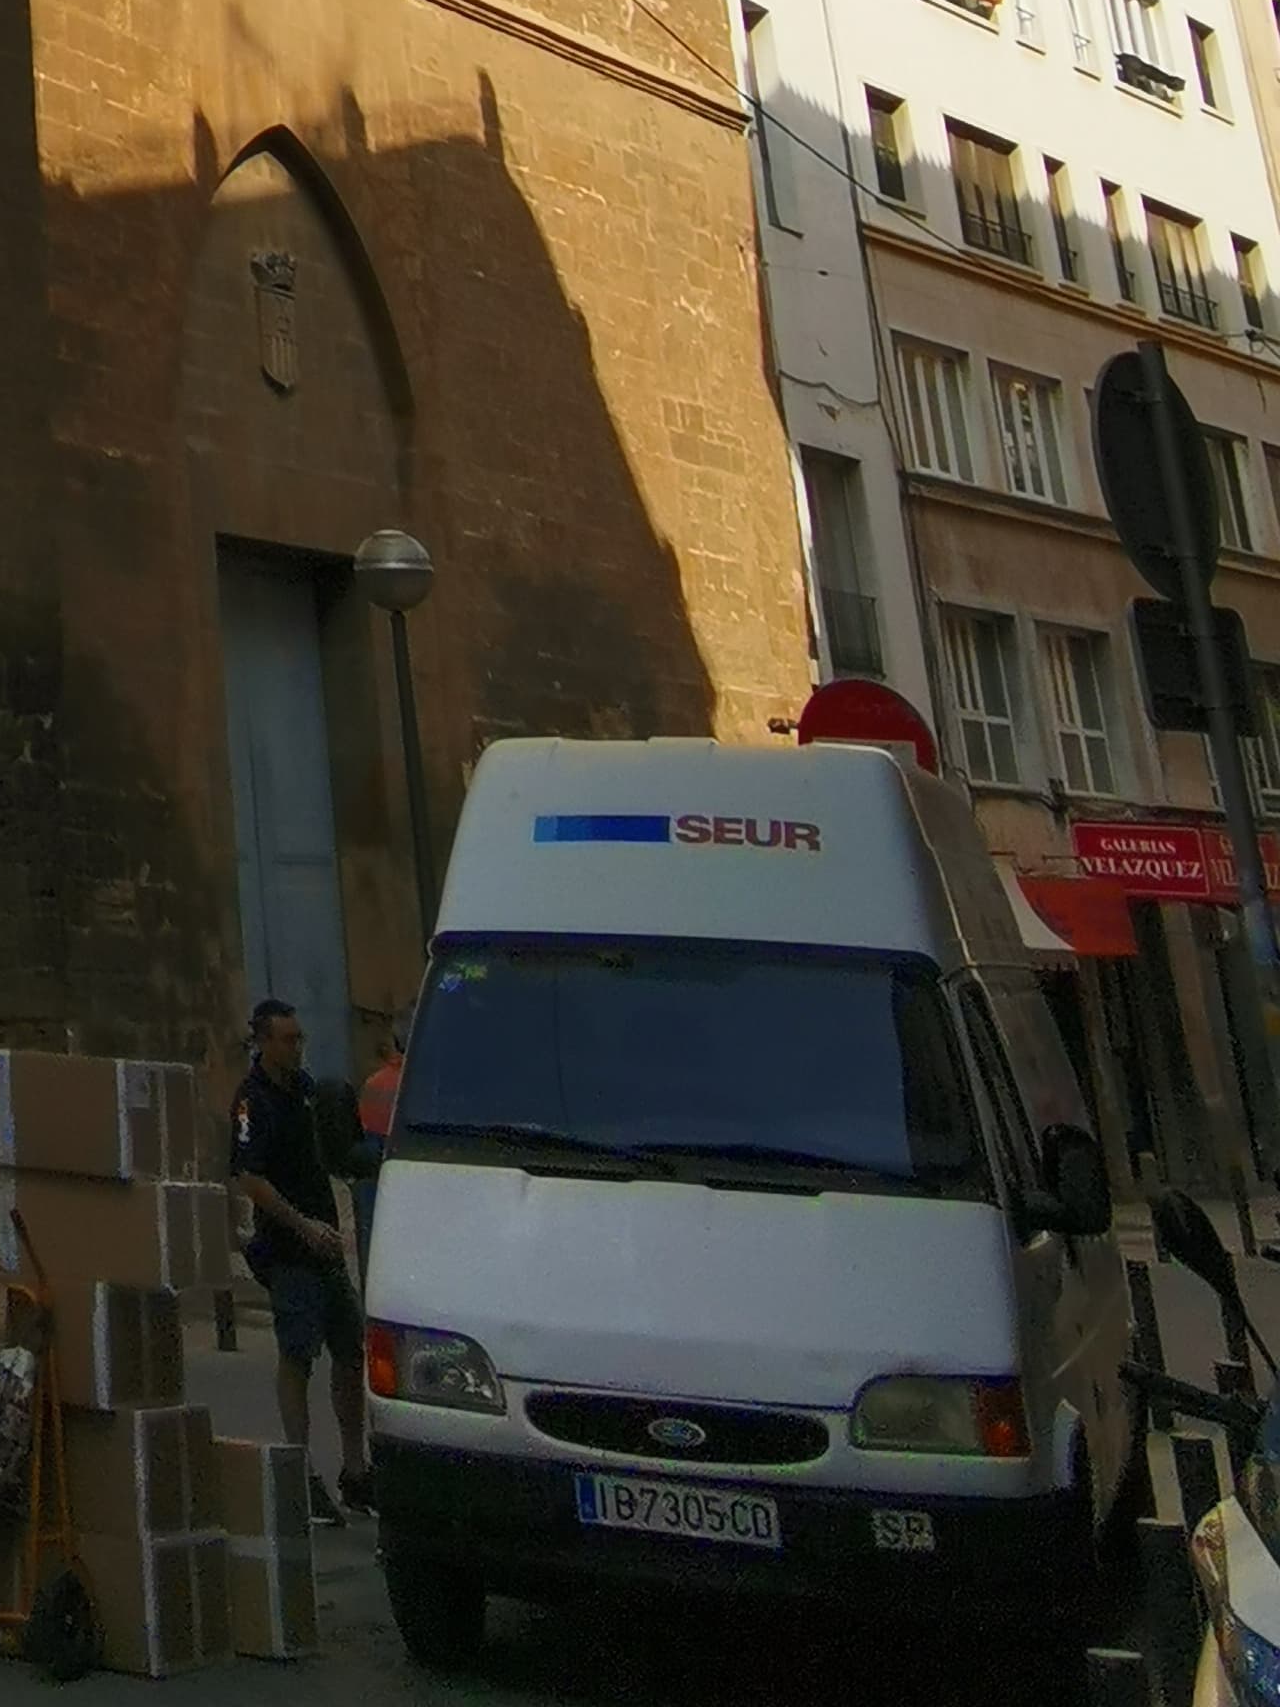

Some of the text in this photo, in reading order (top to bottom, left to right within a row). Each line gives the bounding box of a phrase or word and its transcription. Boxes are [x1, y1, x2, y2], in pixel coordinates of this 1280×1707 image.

[675, 814, 822, 852] SEUR
[1100, 837, 1177, 855] GALERIAS
[1080, 856, 1204, 881] VELAZQUEZ
